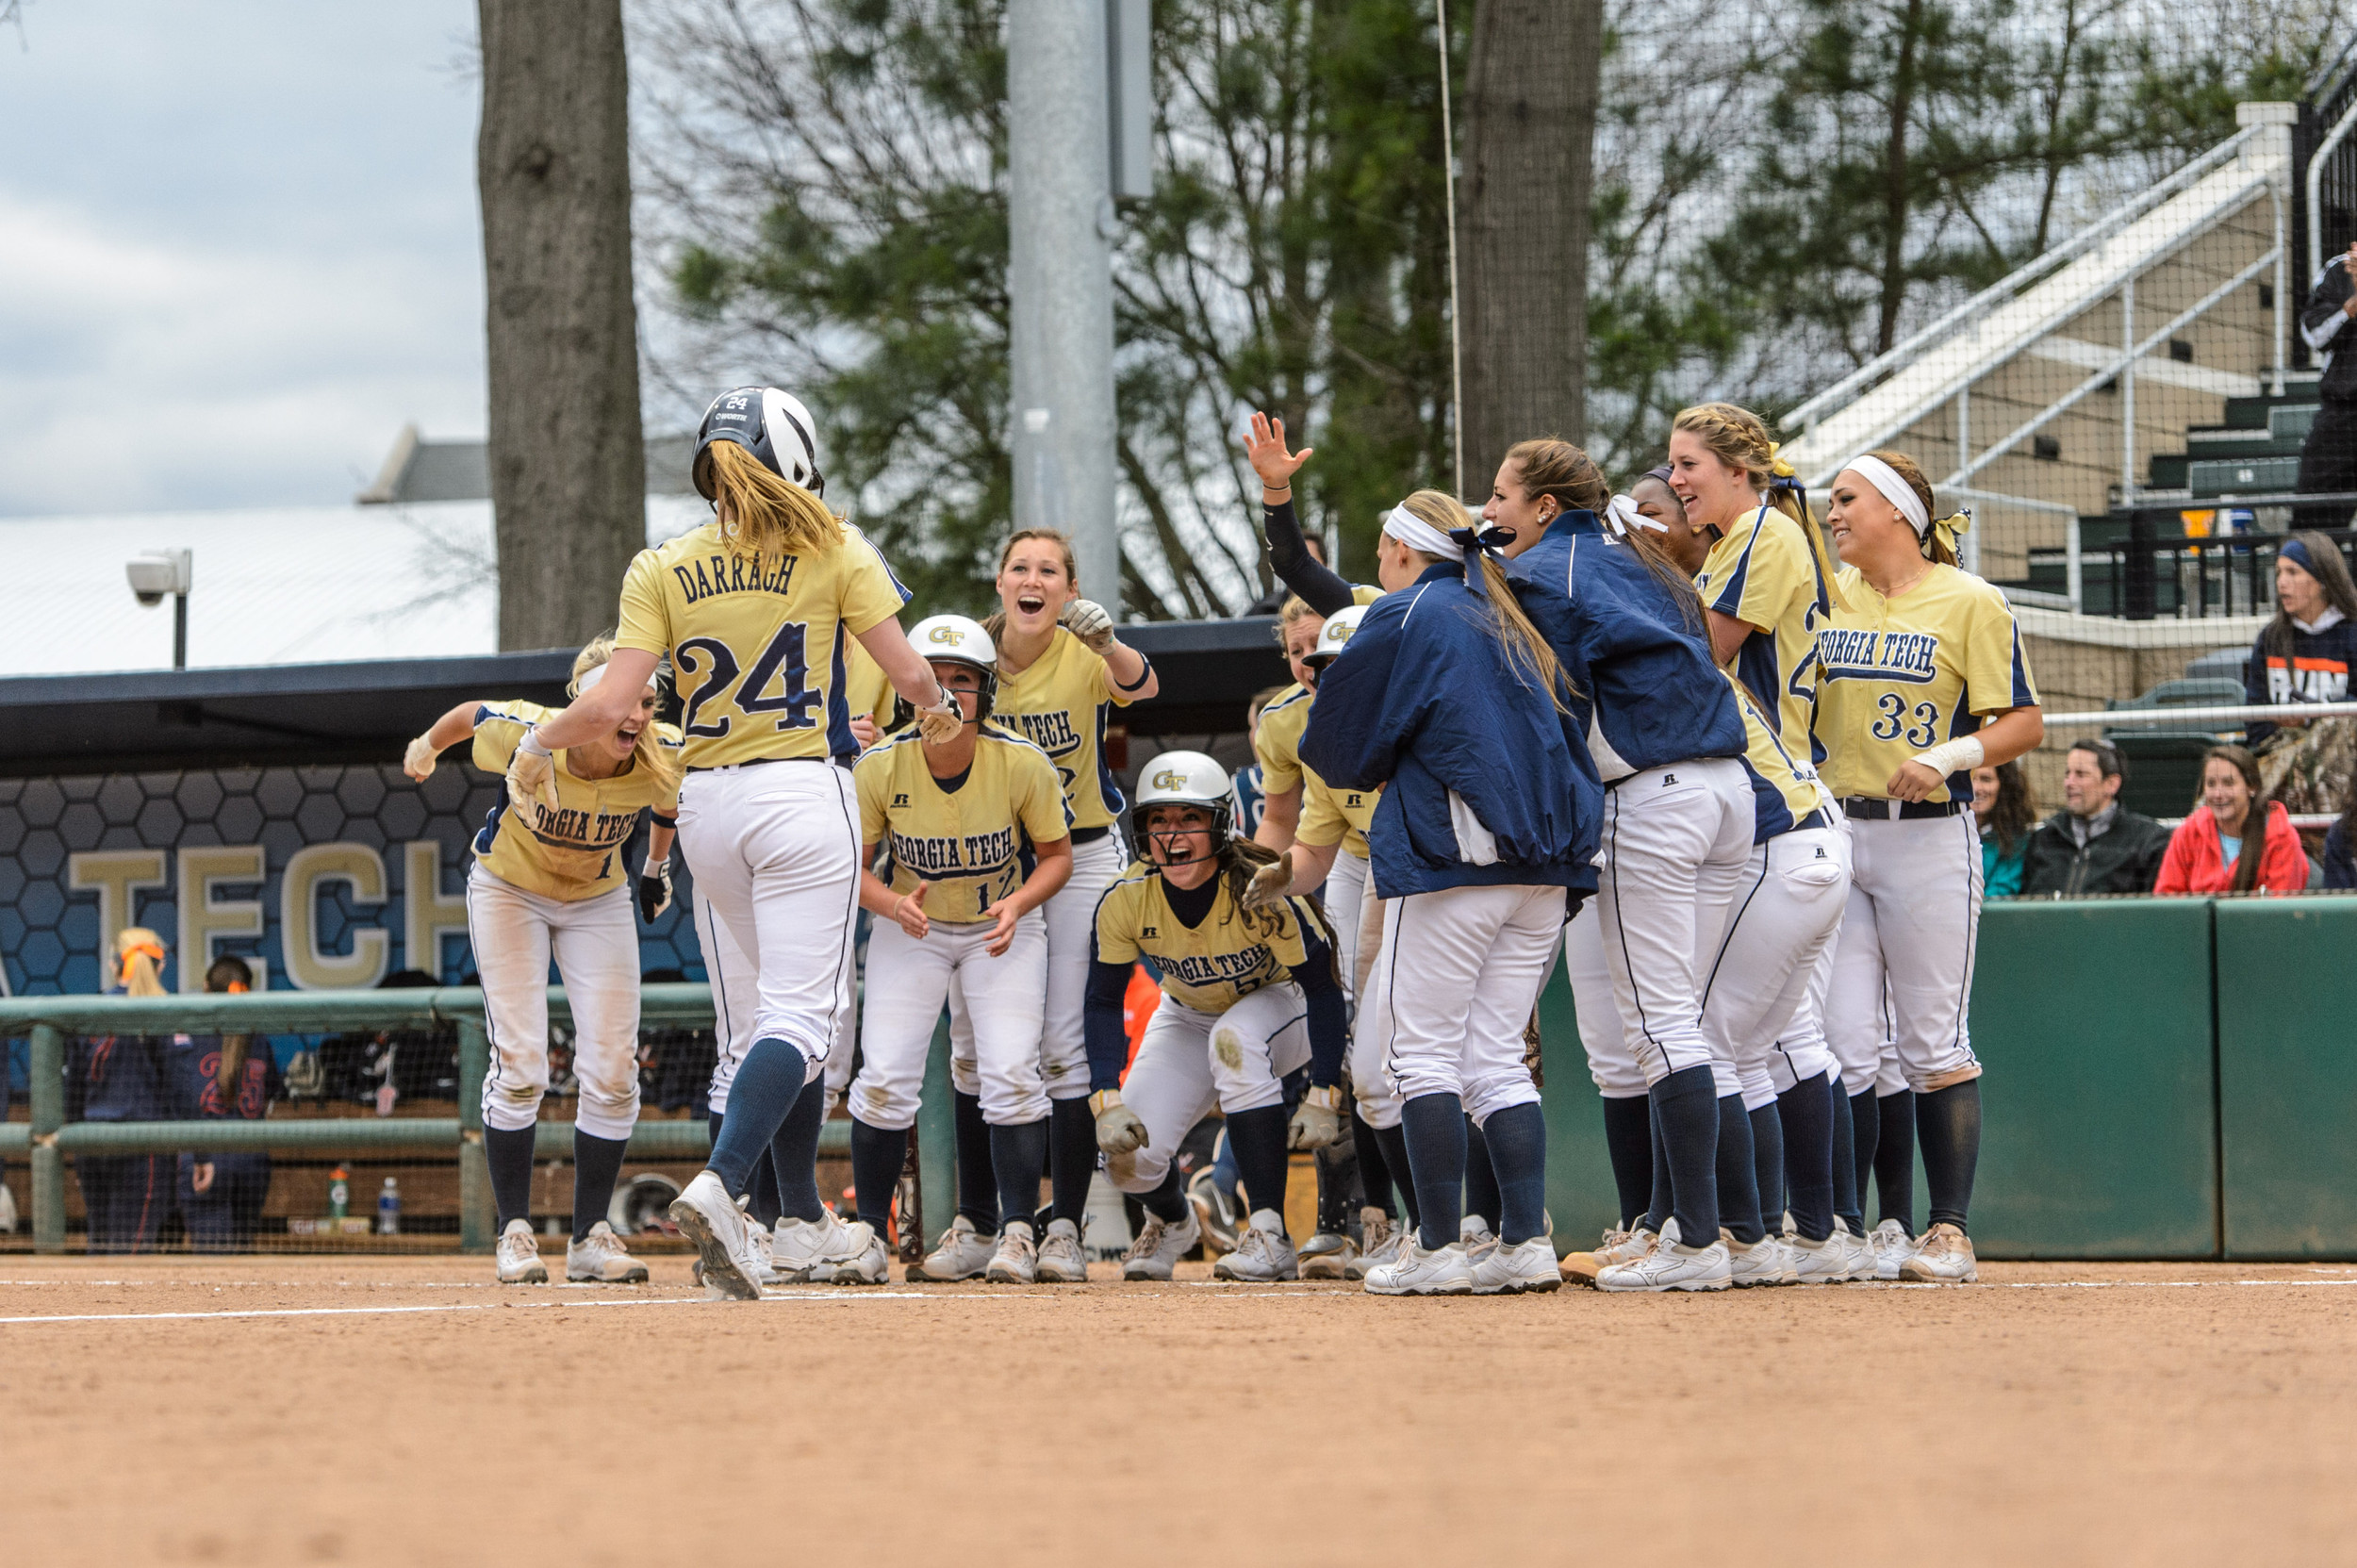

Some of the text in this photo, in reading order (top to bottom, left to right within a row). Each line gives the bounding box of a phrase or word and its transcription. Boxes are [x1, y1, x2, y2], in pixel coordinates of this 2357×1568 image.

[720, 413, 748, 421] WORTH
[726, 397, 748, 410] 24
[673, 551, 799, 604] DARRAGH
[929, 625, 964, 647] GT
[1821, 630, 1937, 673] EORGIA TECH
[675, 620, 824, 739] 24
[1020, 710, 1075, 750] TECH
[1871, 693, 1939, 751] 33
[1152, 769, 1187, 791] GT
[964, 825, 1013, 867] TECH
[595, 851, 613, 881] 1
[1215, 943, 1266, 976] TECH
